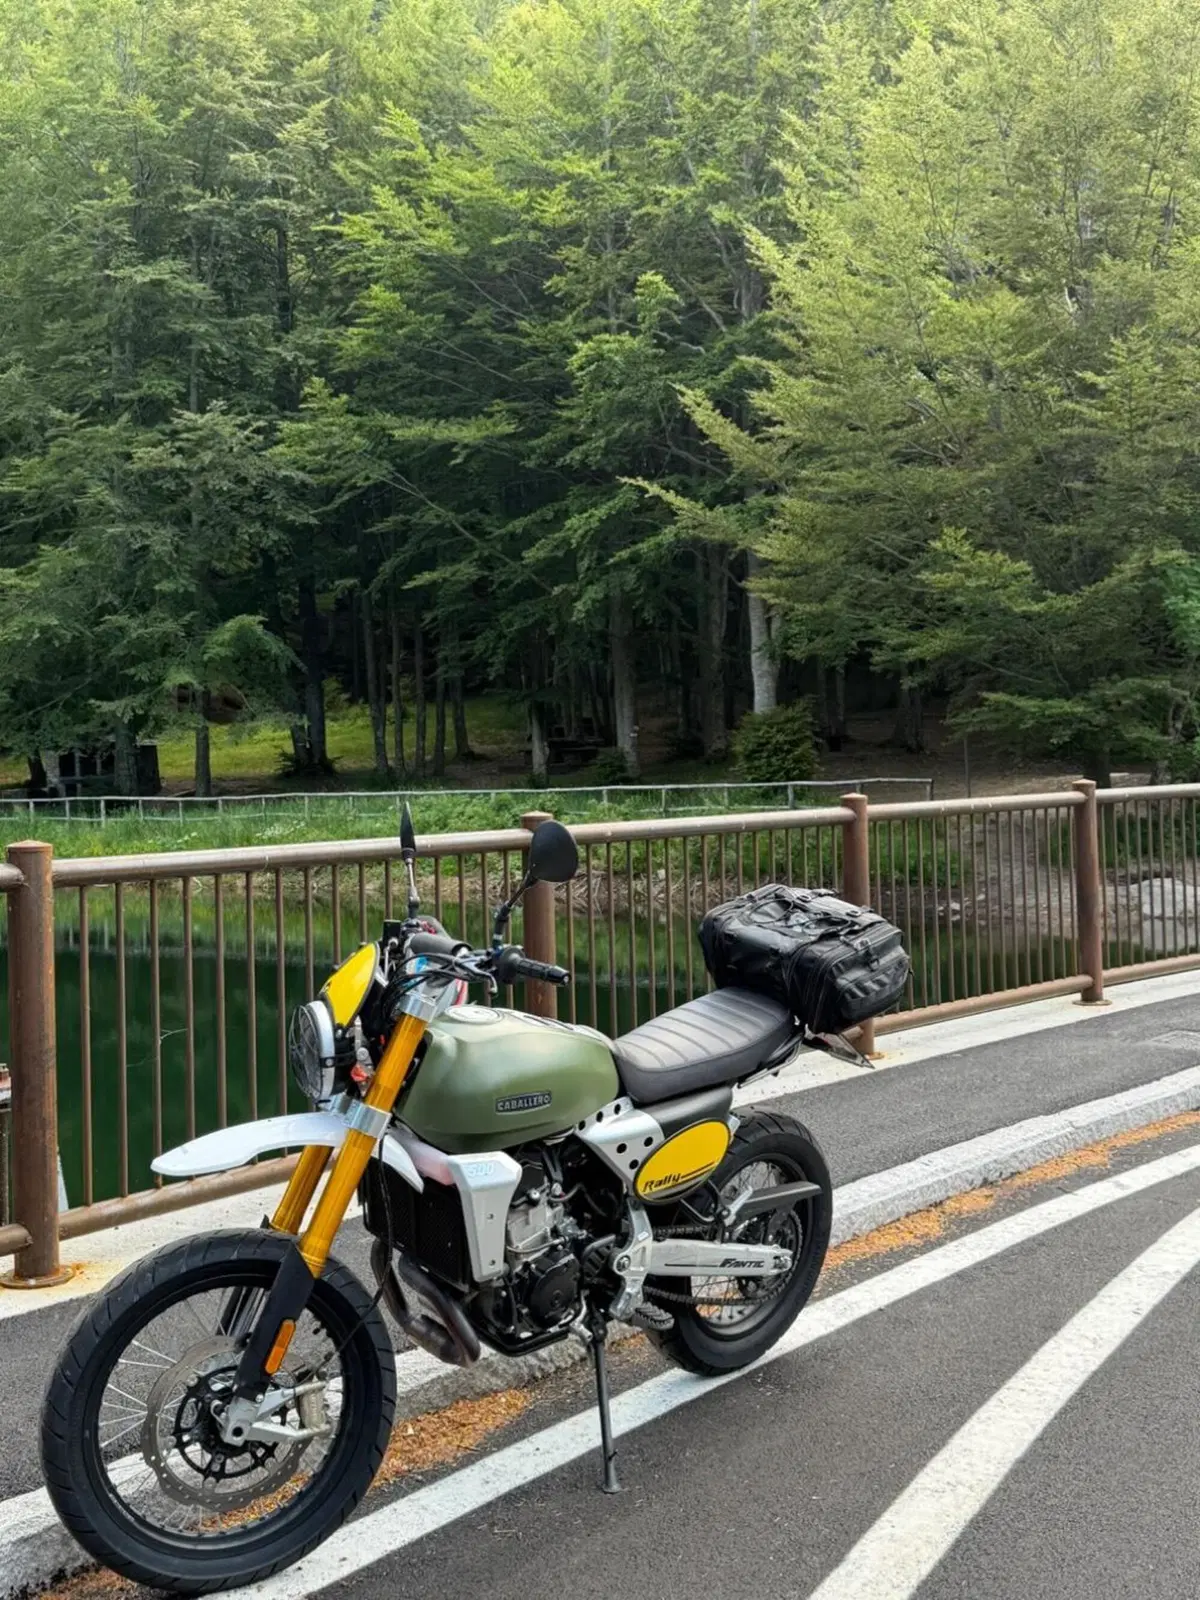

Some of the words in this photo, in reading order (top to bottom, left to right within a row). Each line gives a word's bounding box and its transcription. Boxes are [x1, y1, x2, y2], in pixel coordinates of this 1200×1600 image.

[497, 1094, 551, 1111] CABALLERO
[642, 1173, 681, 1192] Rally
[719, 1258, 765, 1268] FANTIC
